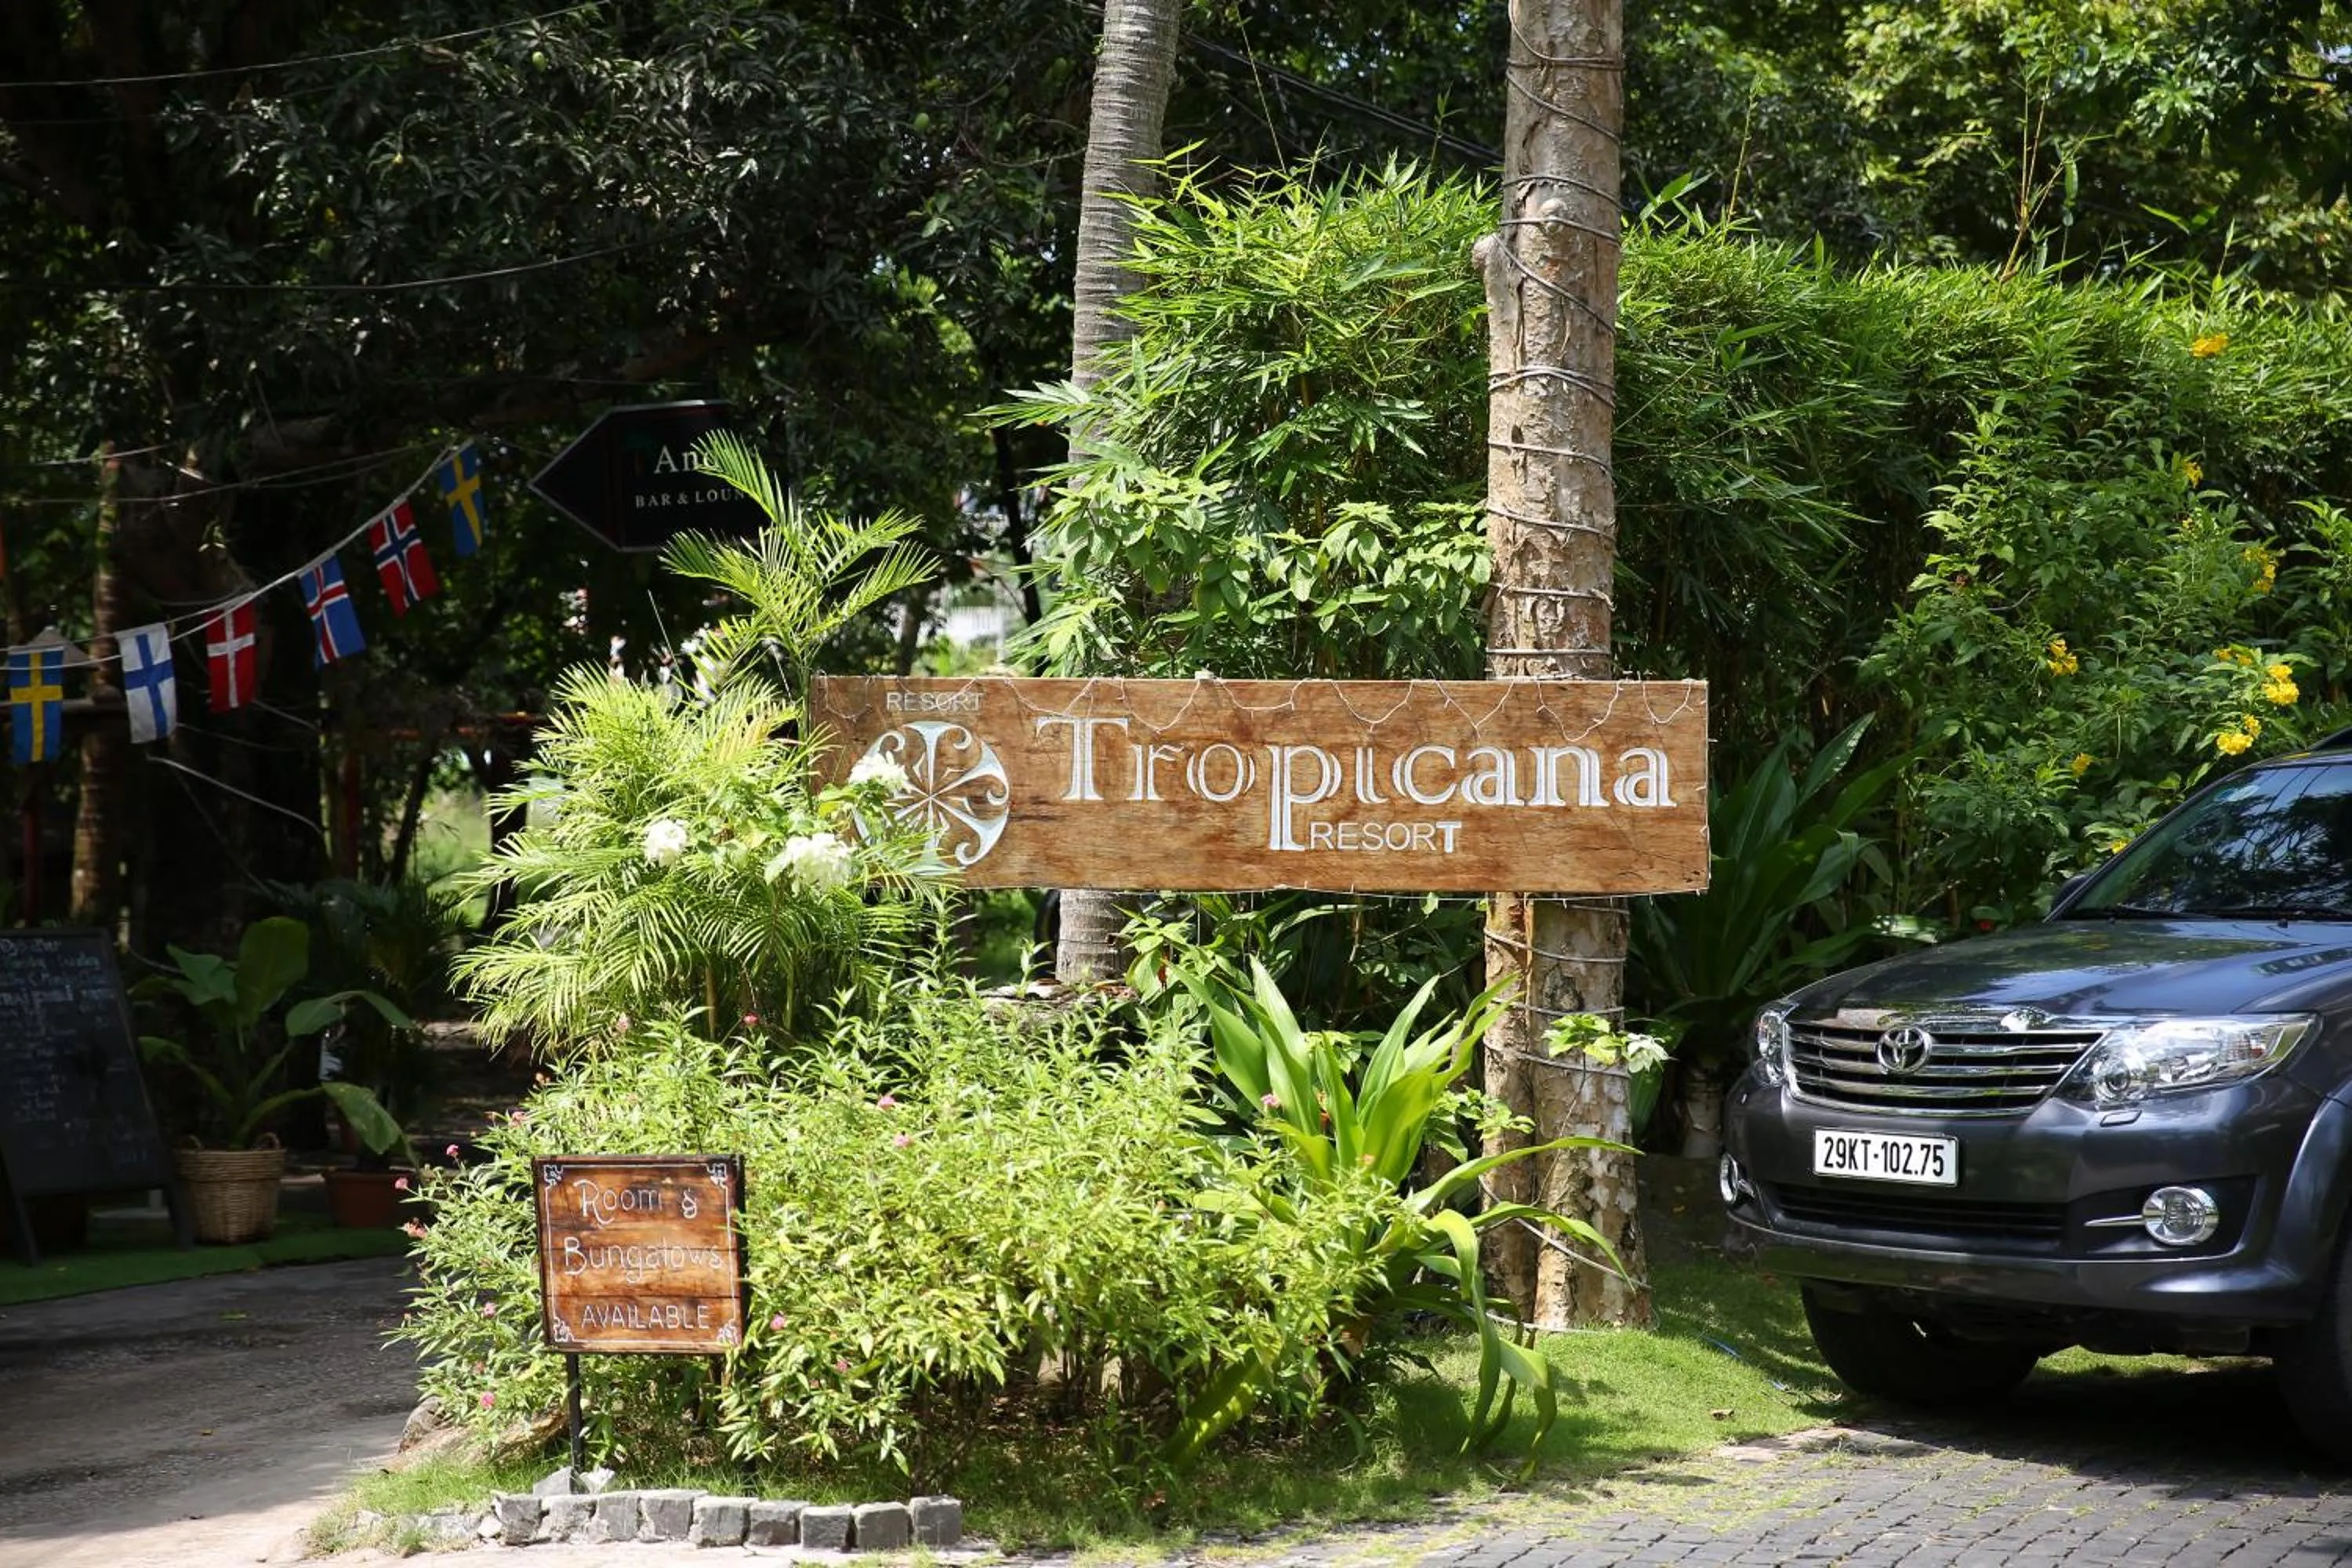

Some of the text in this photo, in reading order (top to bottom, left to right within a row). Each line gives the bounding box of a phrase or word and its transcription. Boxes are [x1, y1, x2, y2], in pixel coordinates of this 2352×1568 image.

[635, 488, 745, 509] BAR & LOUN
[887, 691, 983, 711] RESORT
[1036, 716, 1678, 851] Tropicana
[1310, 821, 1462, 853] RESORT
[572, 1178, 663, 1225] Room
[564, 1236, 723, 1284] Bungalows
[580, 1305, 710, 1330] AVAILABLE
